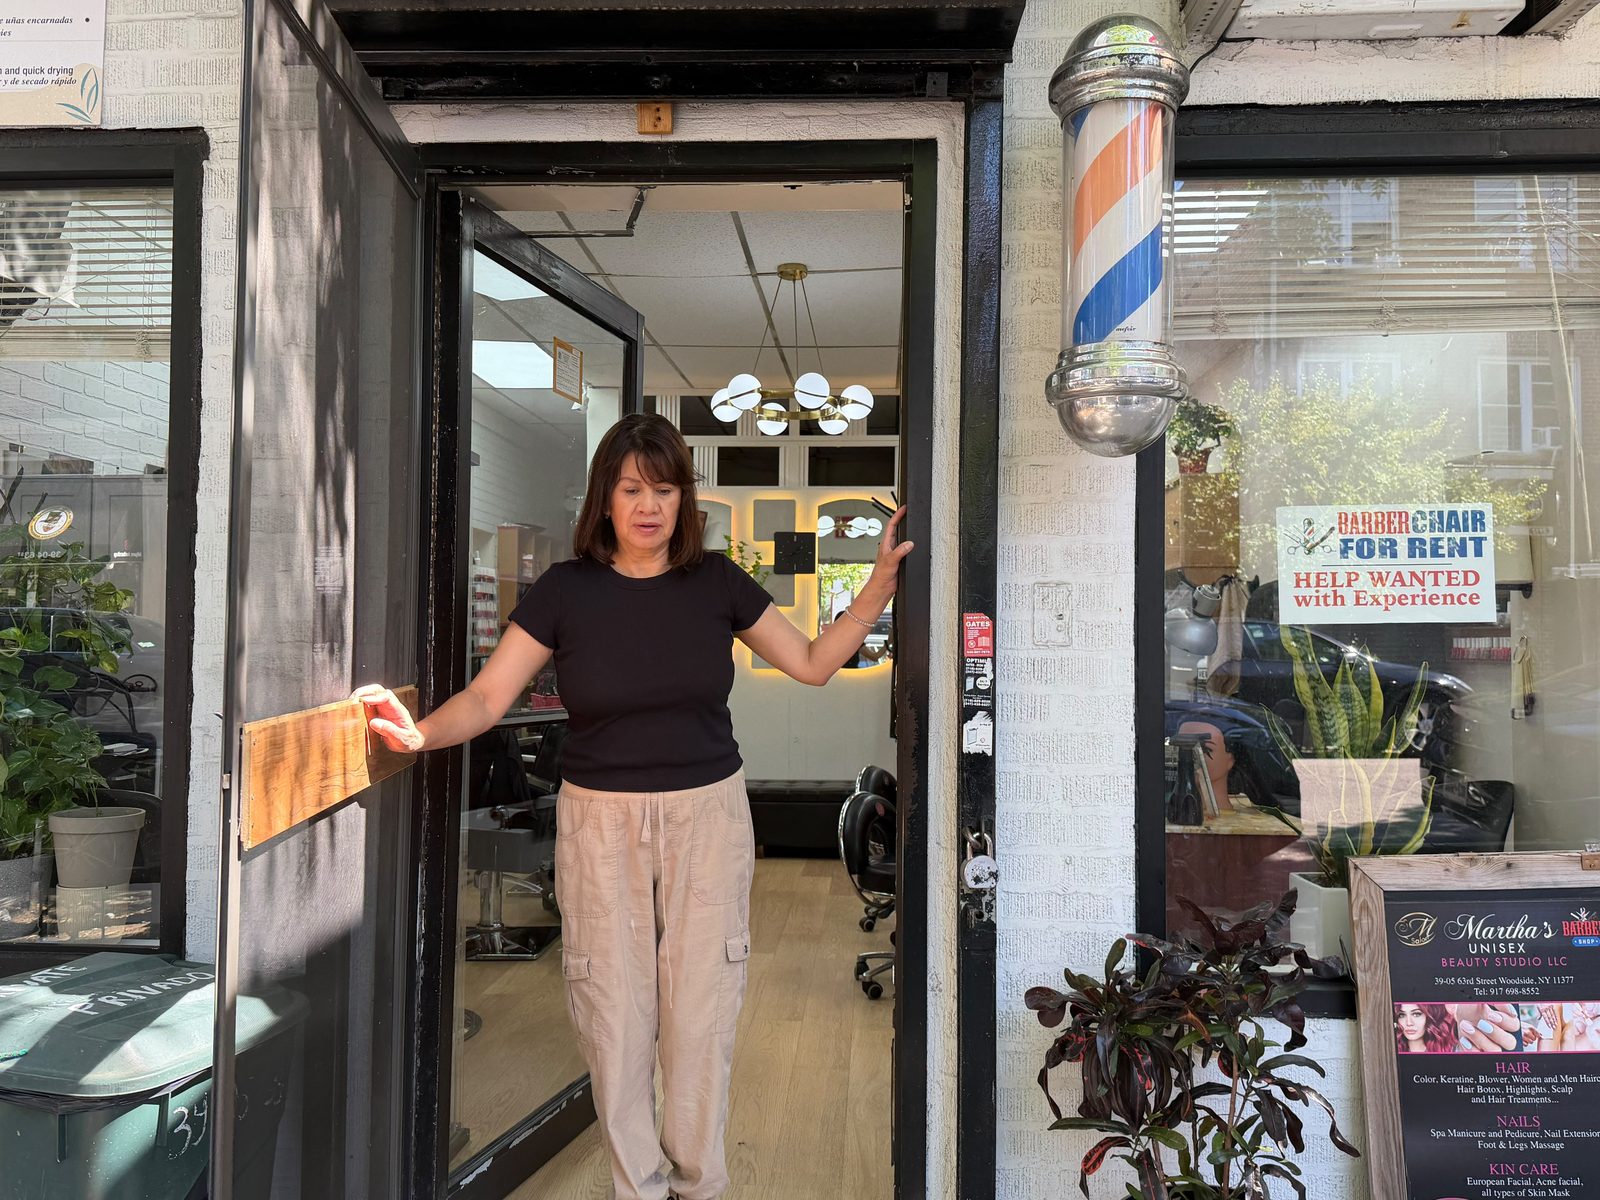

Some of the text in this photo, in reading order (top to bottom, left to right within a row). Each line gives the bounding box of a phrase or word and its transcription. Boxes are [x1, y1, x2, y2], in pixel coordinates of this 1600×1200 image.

[5, 16, 25, 24] uñas
[27, 16, 73, 24] encarnadas
[0, 29, 12, 37] ies
[4, 66, 20, 75] and
[22, 66, 45, 76] quick
[47, 66, 74, 76] drying
[21, 77, 49, 85] secado
[50, 77, 77, 87] rápido
[1337, 511, 1411, 535] BARBER
[1338, 536, 1488, 560] FOR RENT
[1293, 569, 1481, 589] HELP WANTED
[1293, 587, 1481, 612] with Experience
[1443, 913, 1558, 940] Martha's
[1562, 920, 1600, 936] BARBE
[1468, 942, 1526, 954] UNISEX
[1441, 956, 1568, 967] BEAUTY STUDIO LLC
[1434, 977, 1456, 985] 39-05
[1457, 977, 1475, 985] 63rd
[1476, 977, 1498, 985] Street
[1538, 976, 1551, 984] NY
[1553, 976, 1574, 984] 11377
[67, 971, 215, 1016] PRIVADO
[1473, 987, 1540, 996] Tel: 917 698-8552
[1495, 1062, 1531, 1073] HAIR
[1512, 1075, 1542, 1083] Women
[1543, 1074, 1558, 1083] and
[1560, 1074, 1578, 1083] Men
[1457, 1085, 1475, 1094] Hair
[1551, 1084, 1573, 1095] Scalp
[1488, 1095, 1506, 1103] Hair
[1496, 1115, 1541, 1128] NAILS
[1430, 1129, 1446, 1139] Spa
[1448, 1129, 1486, 1138] Manicure
[1488, 1129, 1503, 1138] and
[1544, 1129, 1561, 1138] Nail
[1478, 1140, 1565, 1151] Foot & Legs Massage
[1489, 1163, 1559, 1175] KIN CARE
[1467, 1177, 1505, 1187] European
[1535, 1177, 1557, 1186] Acne
[1481, 1188, 1571, 1198] all types of Skin Mask
